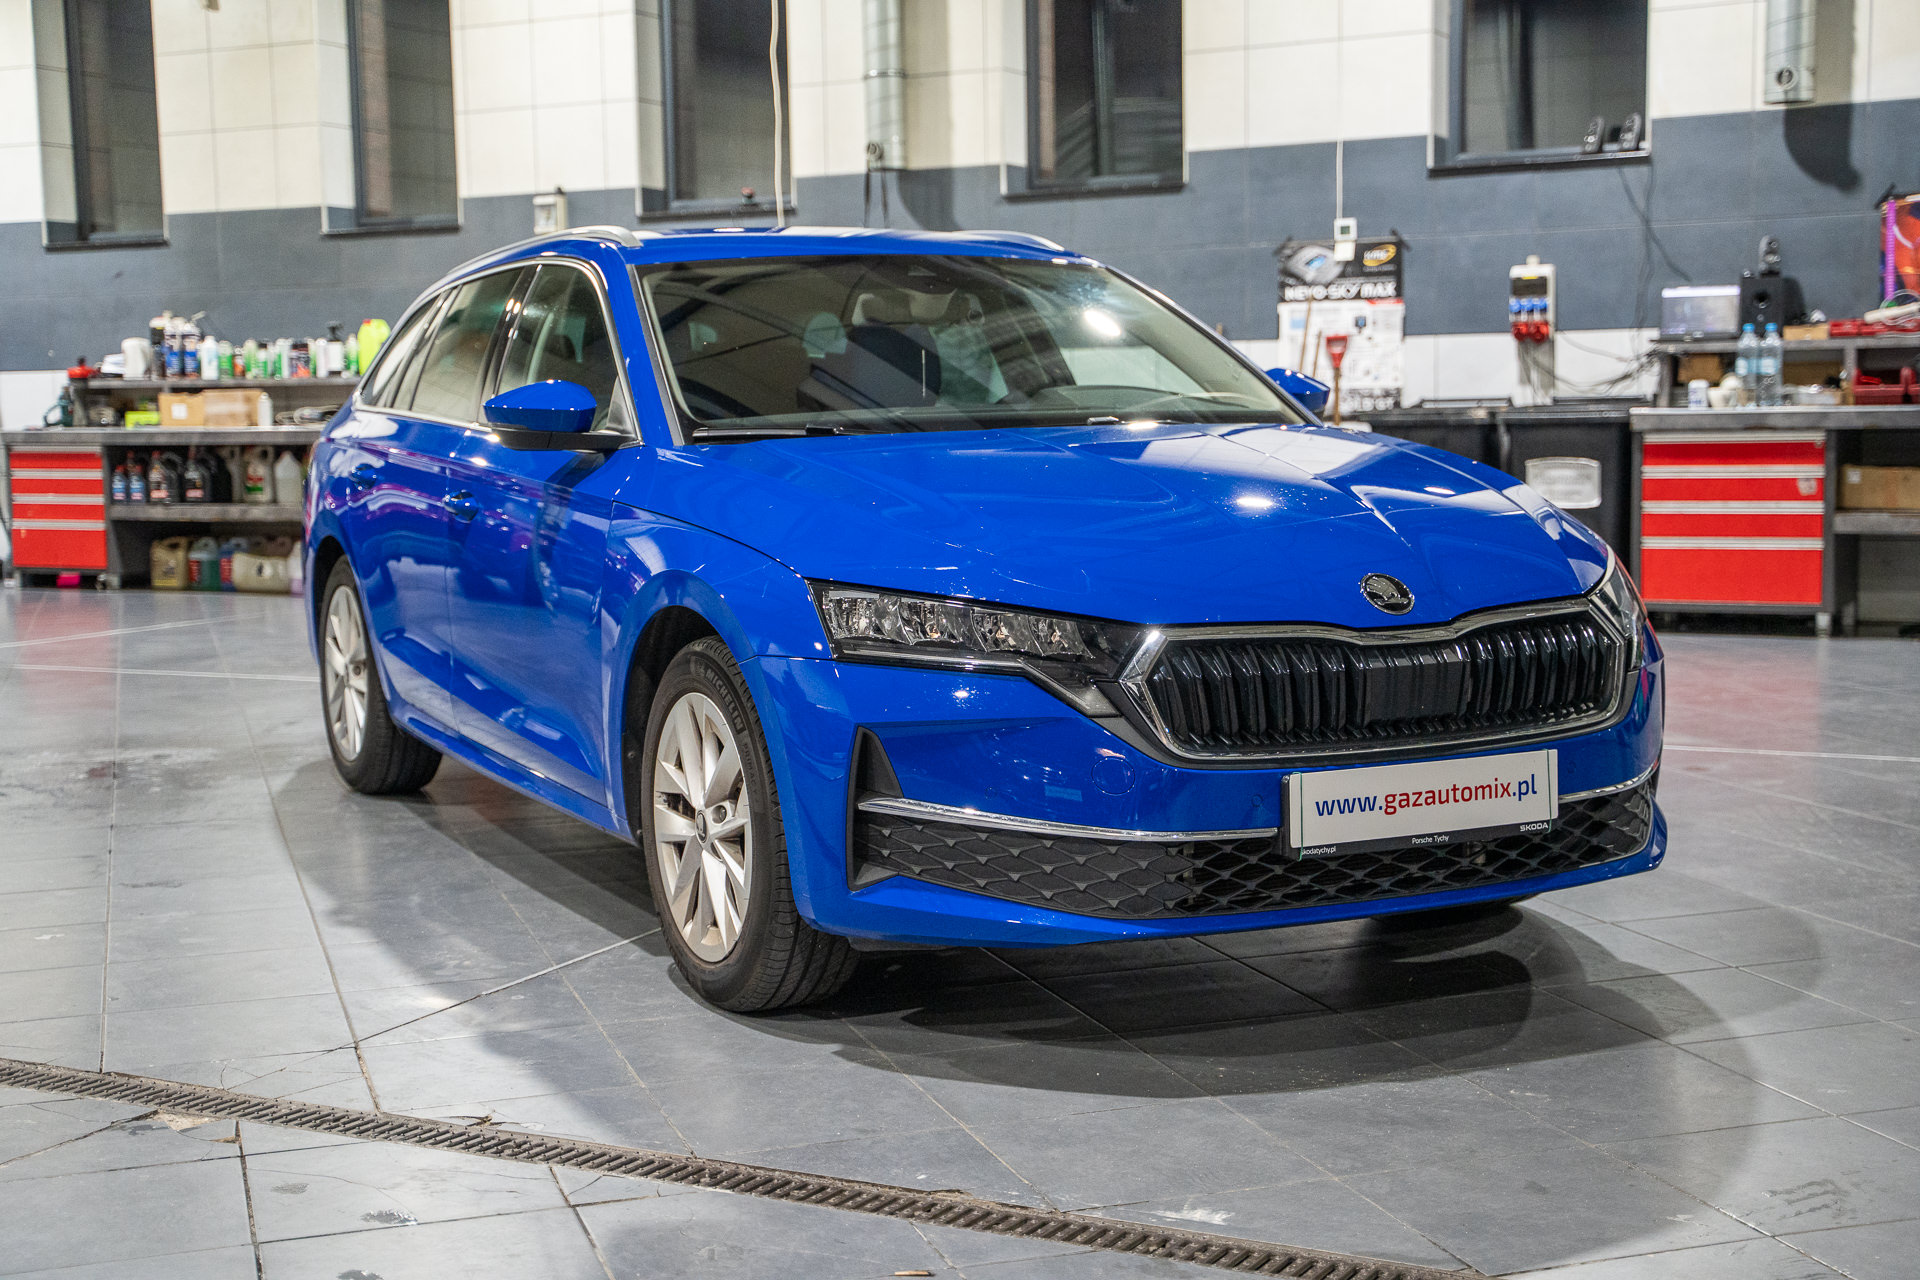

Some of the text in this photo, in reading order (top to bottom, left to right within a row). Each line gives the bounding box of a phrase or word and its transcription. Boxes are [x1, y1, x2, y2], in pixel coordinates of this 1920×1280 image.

[704, 668, 744, 731] MICHELIN
[1315, 773, 1538, 817] www.gazautomix.pl
[1411, 836, 1433, 845] Porsche
[1433, 834, 1450, 844] Tychy
